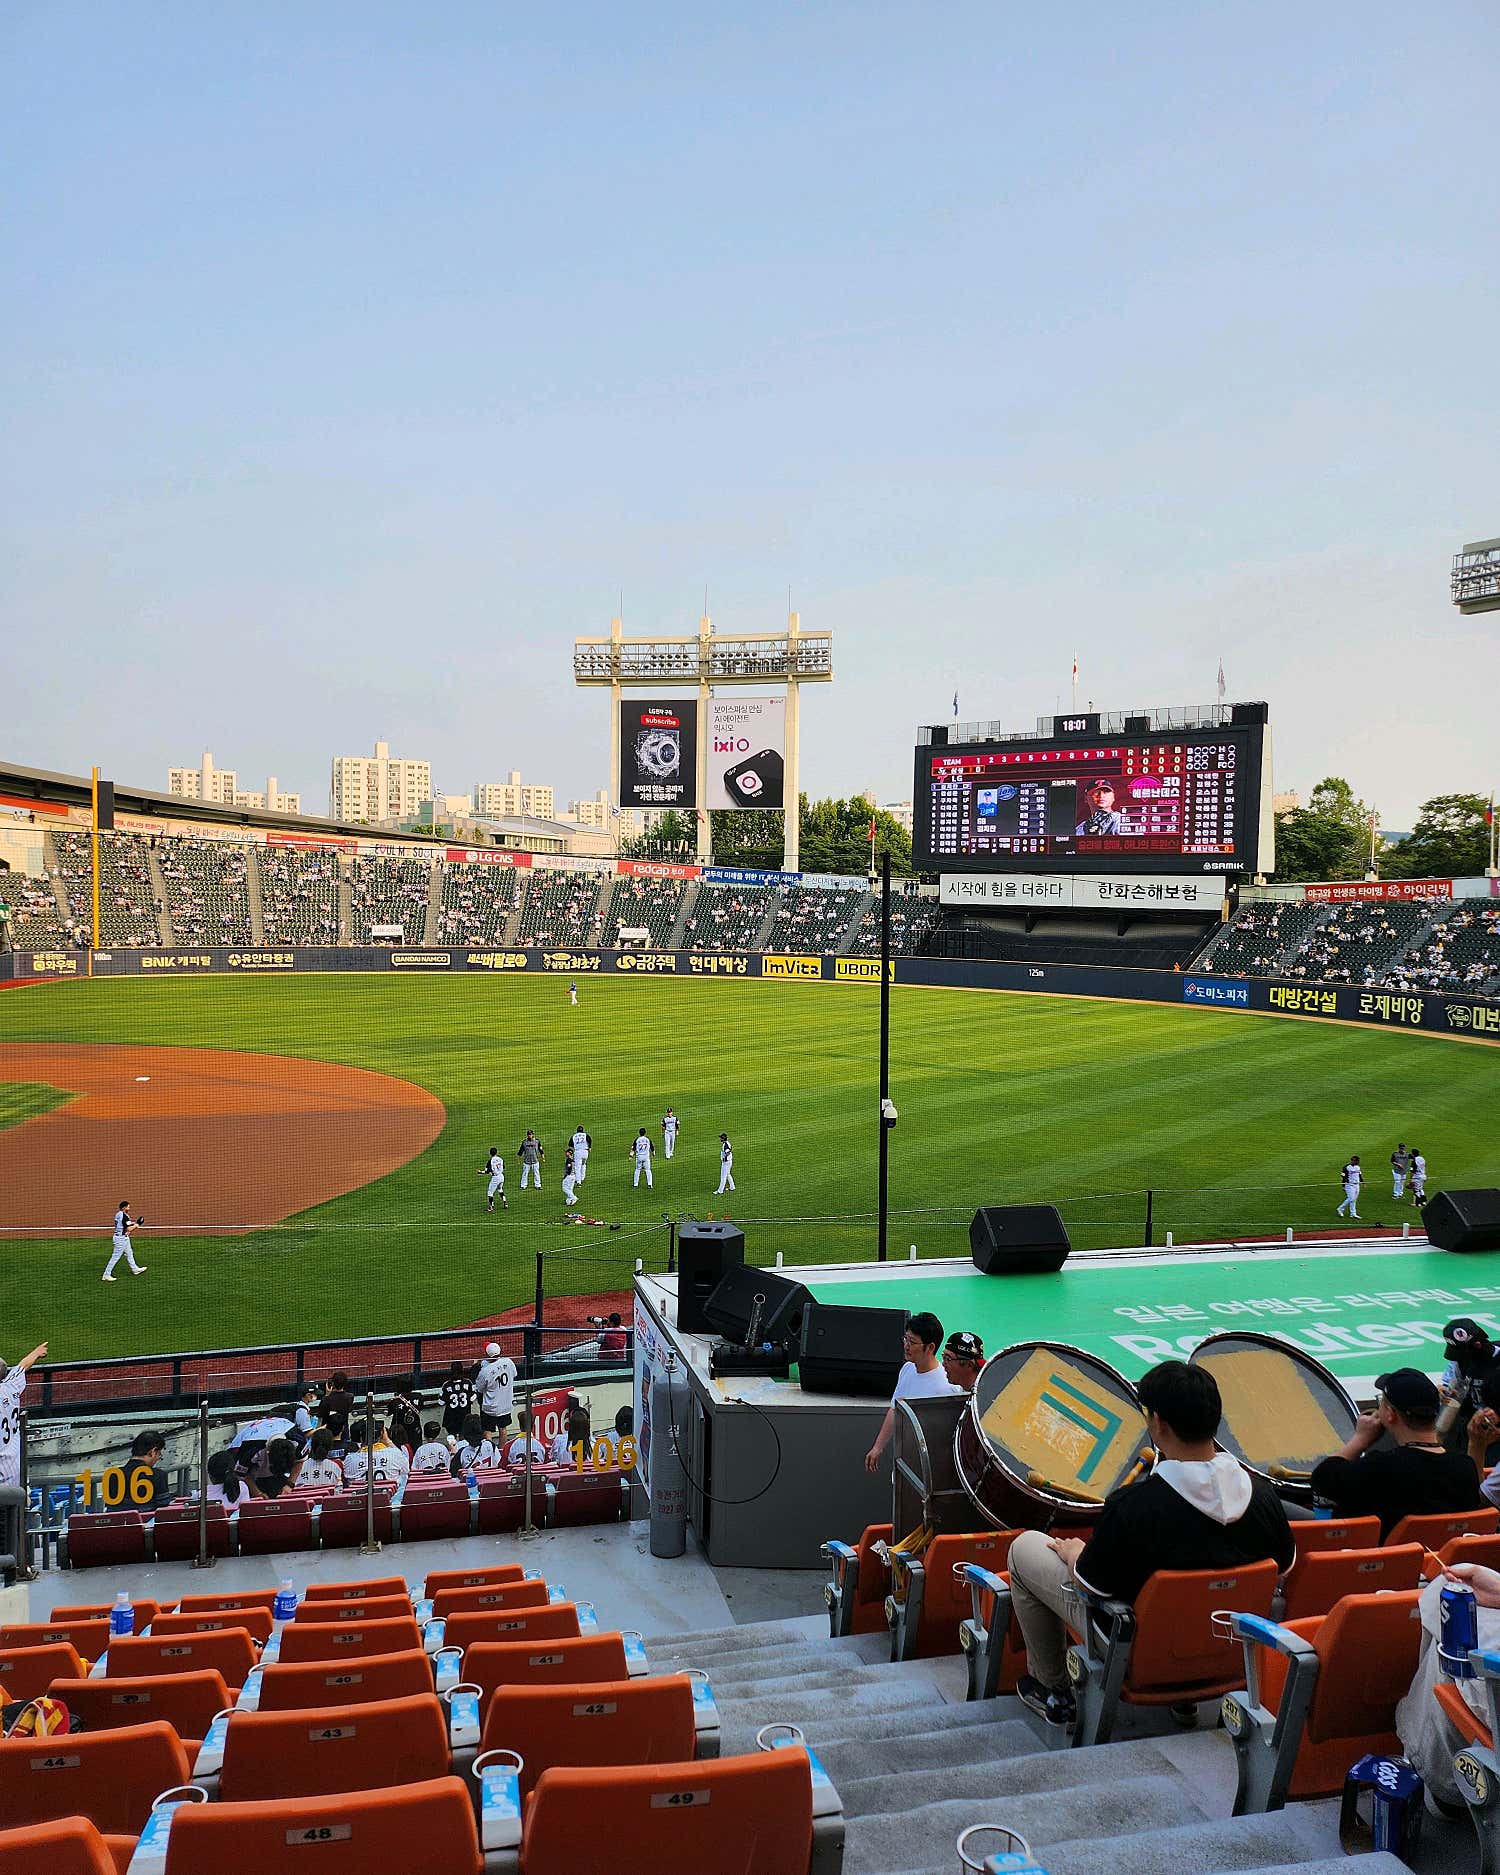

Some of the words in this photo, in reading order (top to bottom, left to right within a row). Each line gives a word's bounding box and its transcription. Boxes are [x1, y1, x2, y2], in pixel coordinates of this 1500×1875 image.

[714, 705, 748, 714] 보이스피싱
[723, 715, 749, 723] 에이전트
[1062, 719, 1086, 732] 18:01
[1163, 777, 1180, 786] 30
[478, 854, 492, 862] LG
[494, 854, 513, 863] CNS
[633, 863, 669, 875] redcap
[704, 870, 723, 879] 모두의
[725, 872, 743, 880] 미래를
[948, 881, 987, 898] 시작에
[991, 882, 1017, 898] 힘을
[1021, 883, 1063, 898] 더하다
[1098, 882, 1198, 901] 한화손해보험
[1308, 888, 1330, 899] 야구와
[1332, 887, 1357, 898] 인생은
[1358, 886, 1383, 897] 타이밍
[1404, 884, 1449, 897] 하이리빙
[142, 957, 176, 967] BNK
[178, 956, 211, 966] 캐피탈
[242, 954, 294, 963] 유안타증권
[636, 955, 676, 971] 금강주택
[689, 956, 748, 973] 현대해상
[1196, 987, 1248, 1002] 도미노피자
[1270, 987, 1337, 1014] 대방건설
[1359, 994, 1424, 1024] 로제비앙
[1113, 1304, 1210, 1324] 일본
[1208, 1298, 1344, 1317] 여행은
[1334, 1288, 1472, 1309] 라쿠텐
[1109, 1314, 1448, 1366] Rauten
[495, 1373, 508, 1388] 10
[450, 1393, 468, 1409] 33
[569, 1436, 637, 1474] 106
[75, 1466, 154, 1506] 106
[538, 1656, 553, 1664] 41
[586, 1705, 605, 1713] 42
[1226, 1700, 1238, 1715] 207
[321, 1729, 341, 1738] 43
[44, 1758, 65, 1768] 44
[1460, 1758, 1479, 1780] 207
[667, 1792, 694, 1805] 49
[304, 1828, 331, 1840] 48
